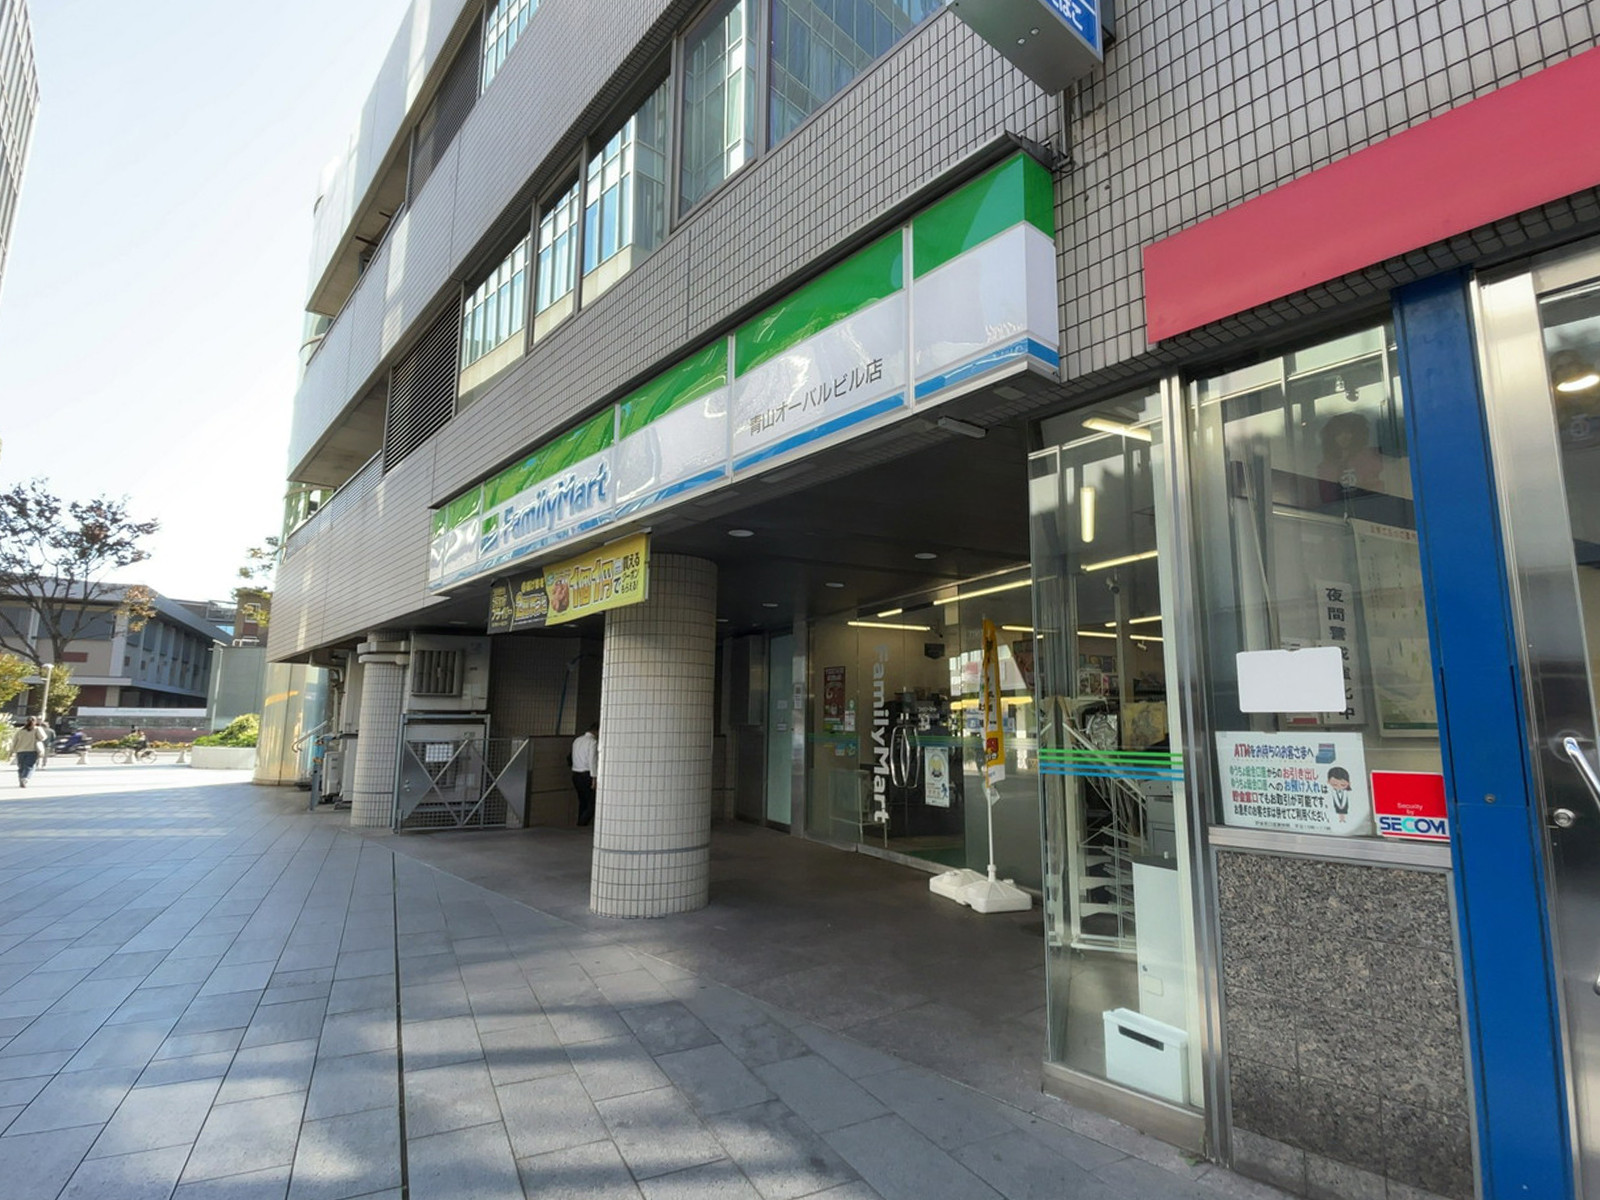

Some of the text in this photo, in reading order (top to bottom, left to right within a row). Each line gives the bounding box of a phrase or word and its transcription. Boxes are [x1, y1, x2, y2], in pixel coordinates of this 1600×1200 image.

[749, 358, 883, 436] 青山オーバルビル店
[503, 462, 608, 544] FamilyMart
[871, 644, 890, 823] FamilyMart
[1234, 743, 1314, 760] ATMをお待ちのお客さまへ
[1379, 816, 1447, 835] SECOM
[1397, 802, 1423, 811] Security
